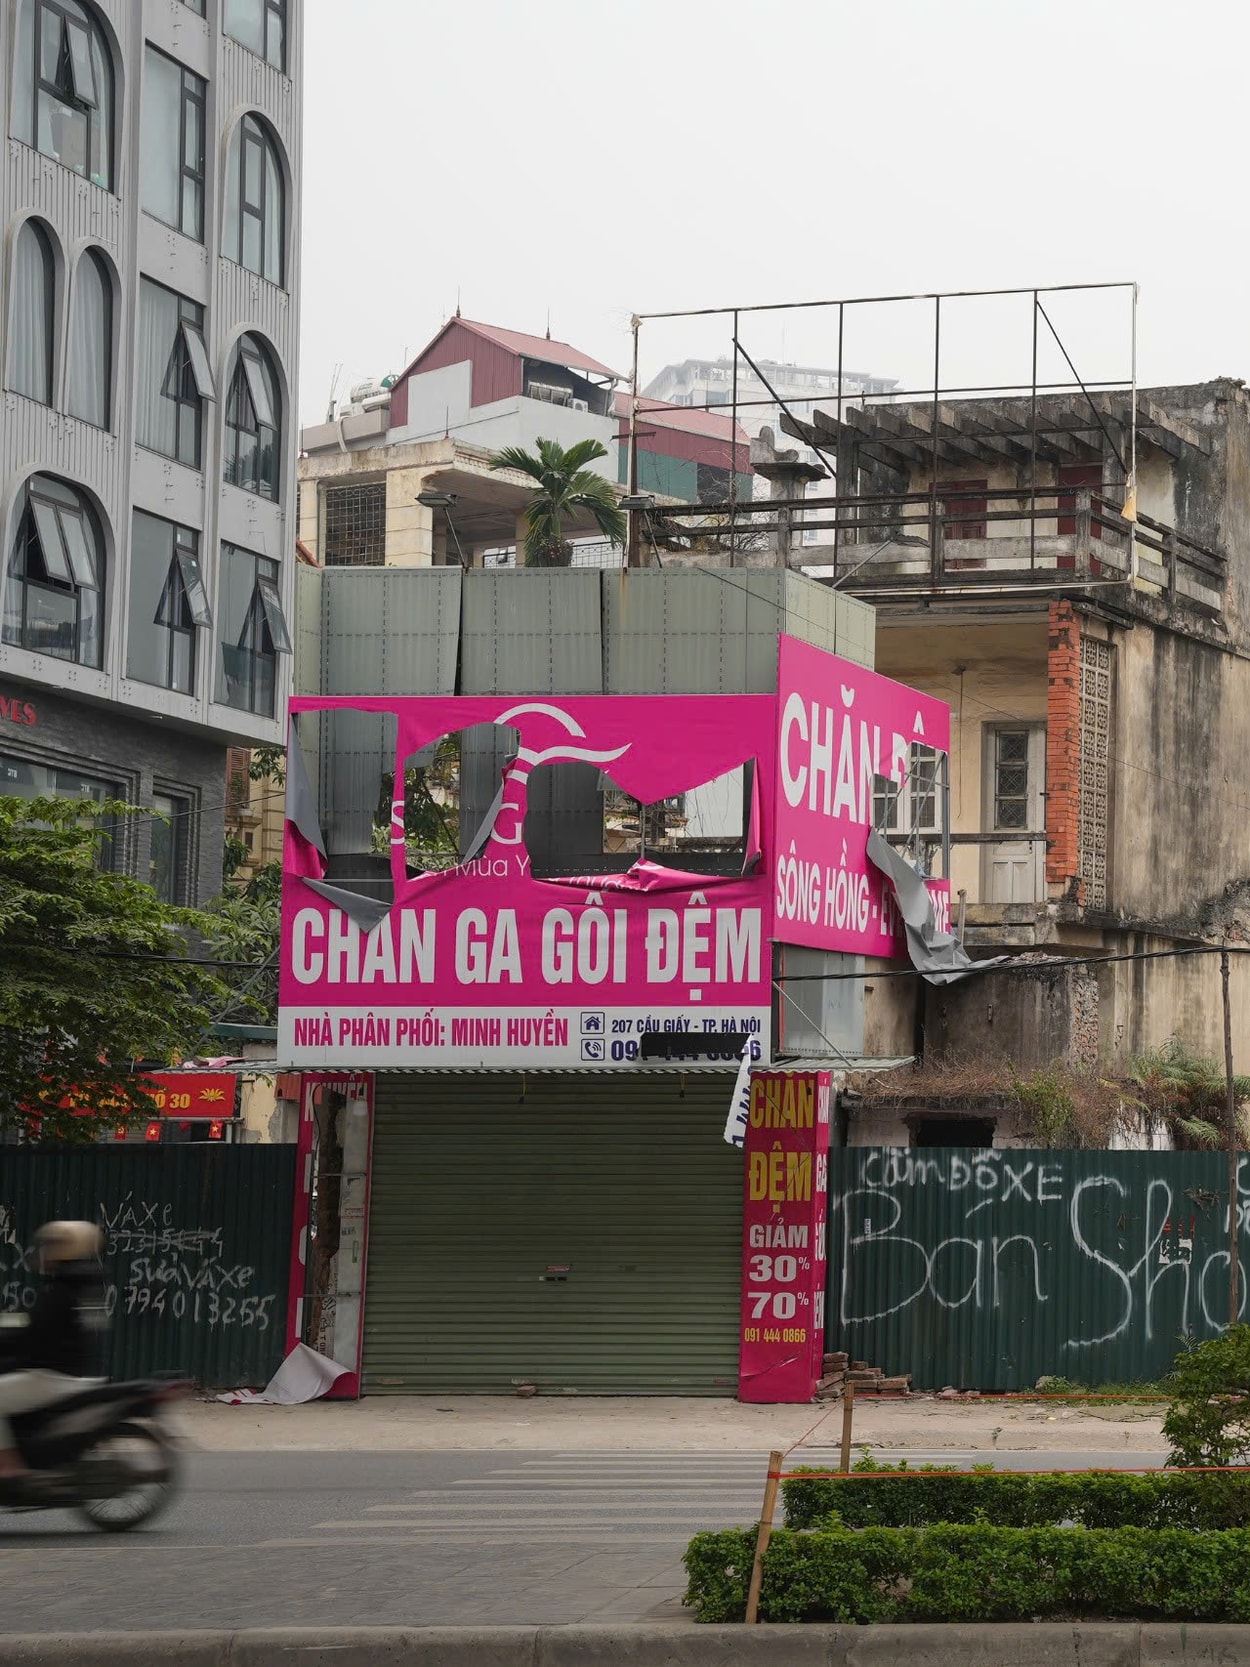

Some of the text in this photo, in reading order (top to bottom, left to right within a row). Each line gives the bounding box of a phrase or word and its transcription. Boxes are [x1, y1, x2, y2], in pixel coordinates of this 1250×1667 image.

[777, 839, 821, 926] SÔNG
[825, 837, 870, 934] HỒNG
[455, 907, 523, 985] GA
[645, 892, 761, 1001] ĐỆM
[294, 1007, 569, 1047] NHÀ PHÂN PHỐI: MINH HUYỀN
[611, 1019, 633, 1033] 207
[636, 1014, 660, 1033] CẦU
[663, 1014, 691, 1033] GIẤY
[721, 1016, 737, 1033] HÀ
[169, 1093, 191, 1109] 30
[750, 1071, 815, 1129] CHĂN
[748, 1140, 812, 1213] ĐỆM
[749, 1217, 809, 1249] GIẢM
[749, 1254, 810, 1282] 30%
[747, 1292, 809, 1320] 70%
[744, 1327, 806, 1343] 091 444 0866
